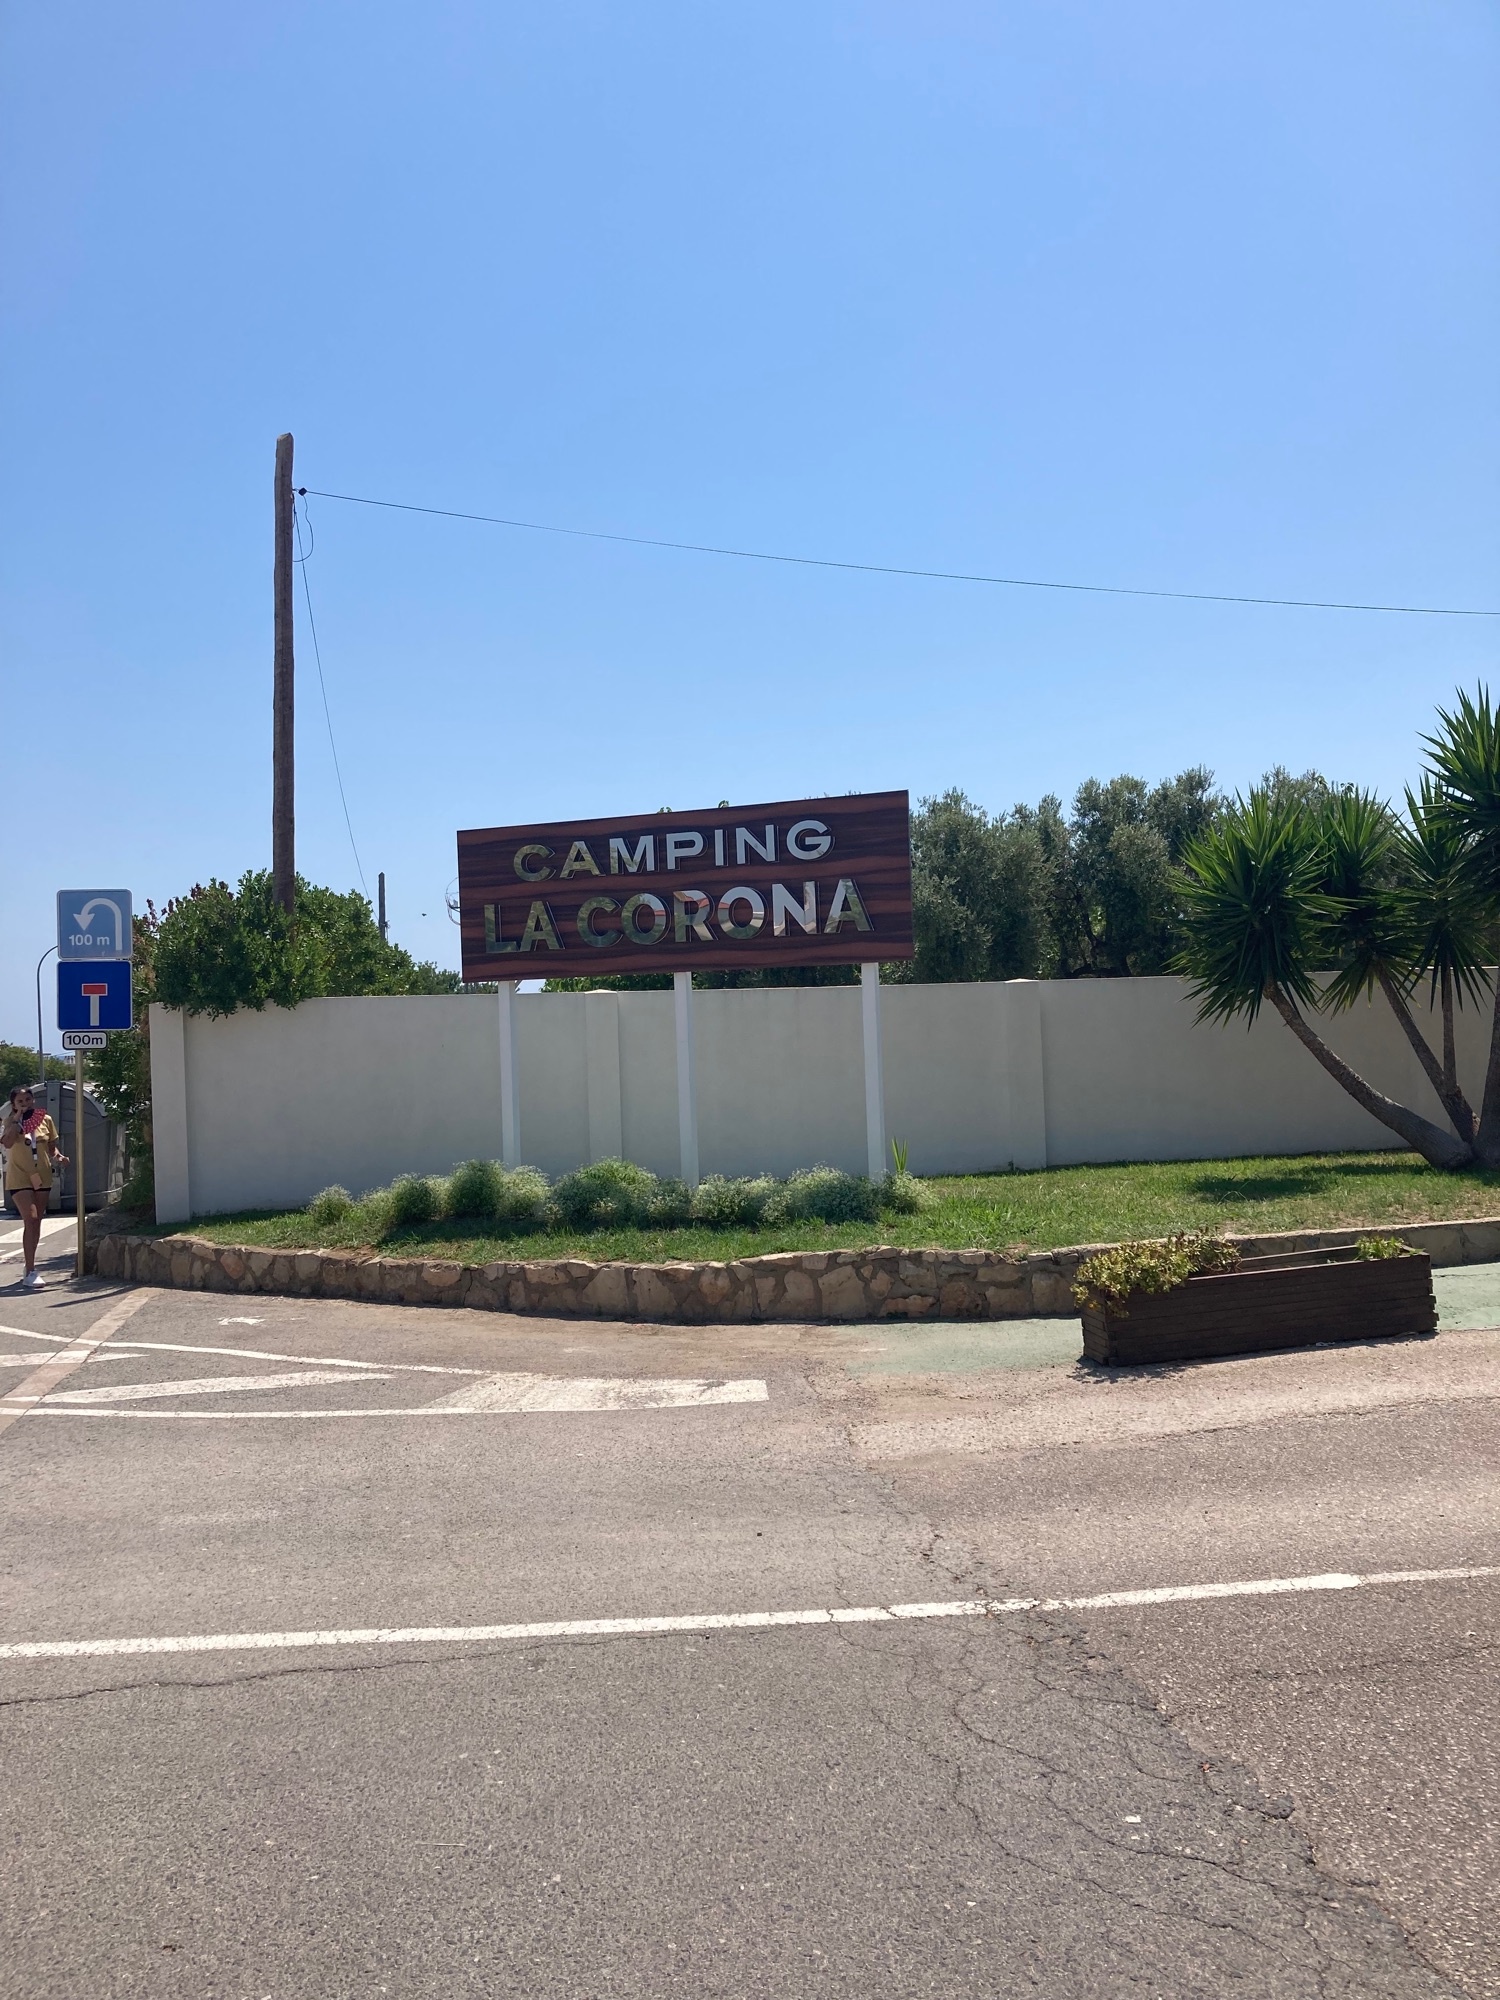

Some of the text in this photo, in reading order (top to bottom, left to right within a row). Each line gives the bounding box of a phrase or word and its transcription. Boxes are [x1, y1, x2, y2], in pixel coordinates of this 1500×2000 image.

[513, 819, 833, 882] CAMPING
[484, 878, 874, 954] LA CORONA
[68, 934, 110, 946] 100 m
[66, 1034, 103, 1046] 100m
